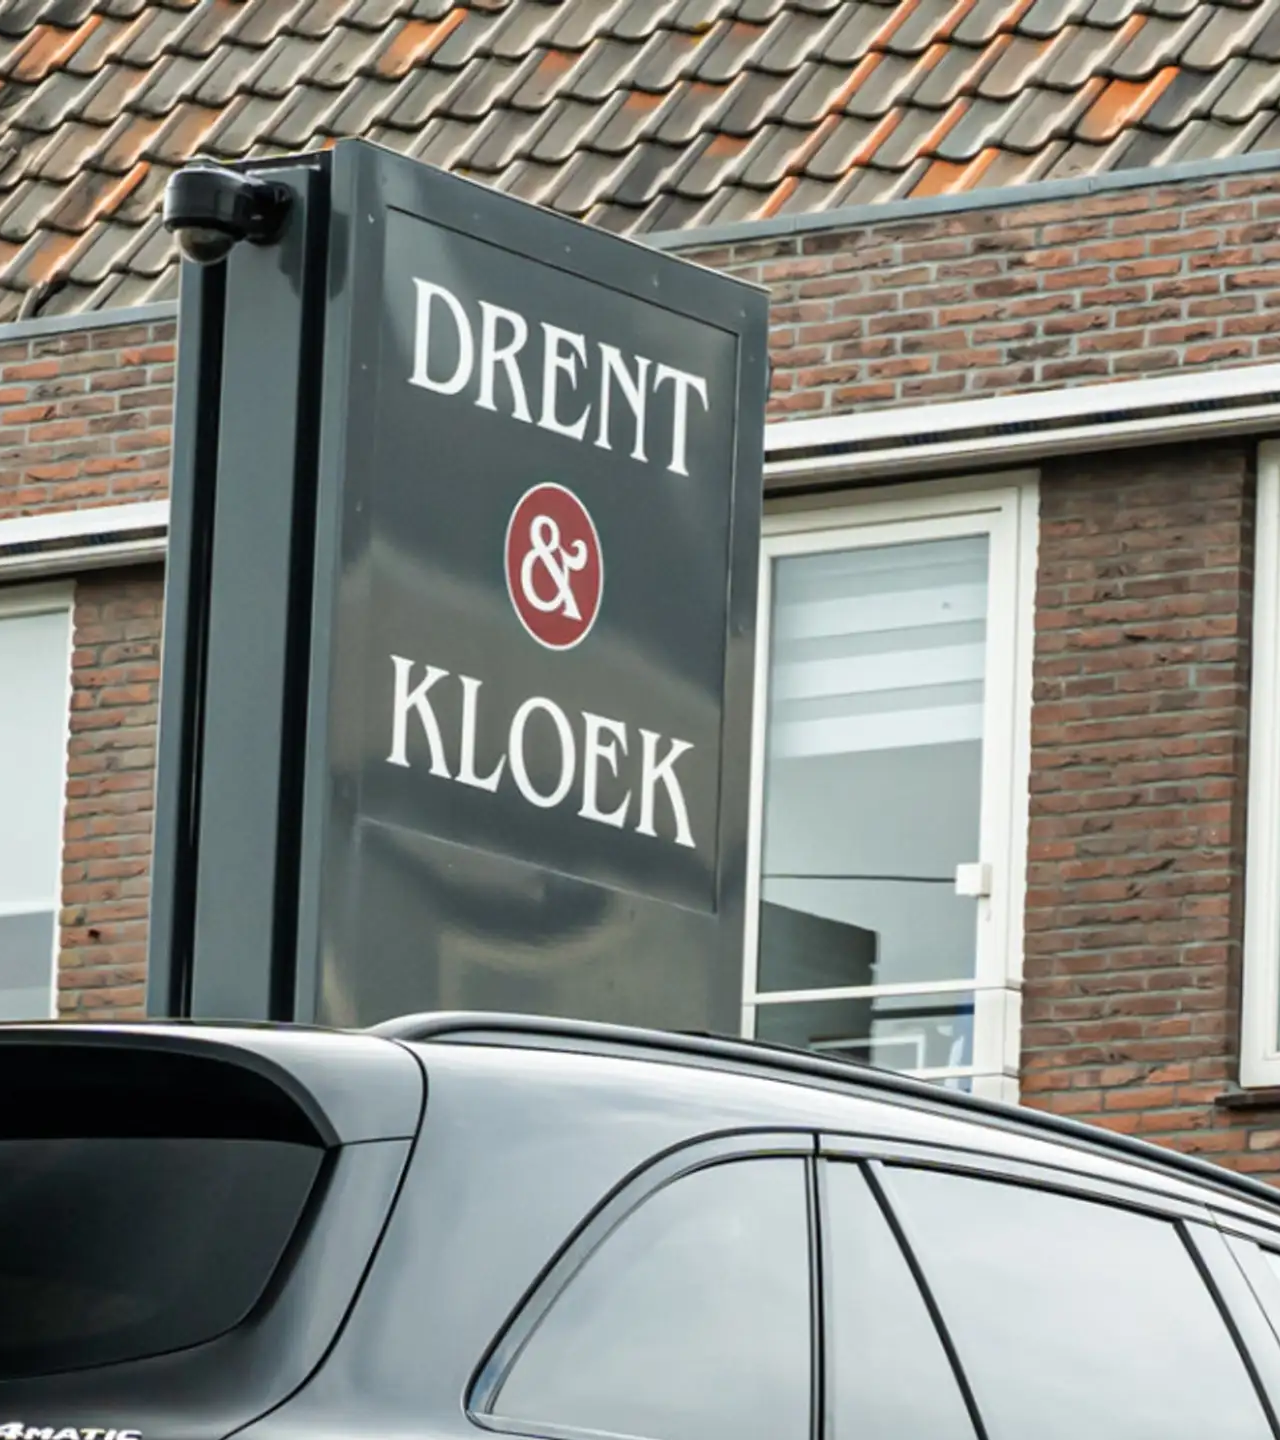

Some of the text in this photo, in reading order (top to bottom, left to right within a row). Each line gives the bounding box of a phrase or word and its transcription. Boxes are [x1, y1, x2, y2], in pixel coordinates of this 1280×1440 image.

[407, 276, 709, 478] DRENT
[520, 514, 588, 621] &
[385, 655, 696, 848] KLOEK
